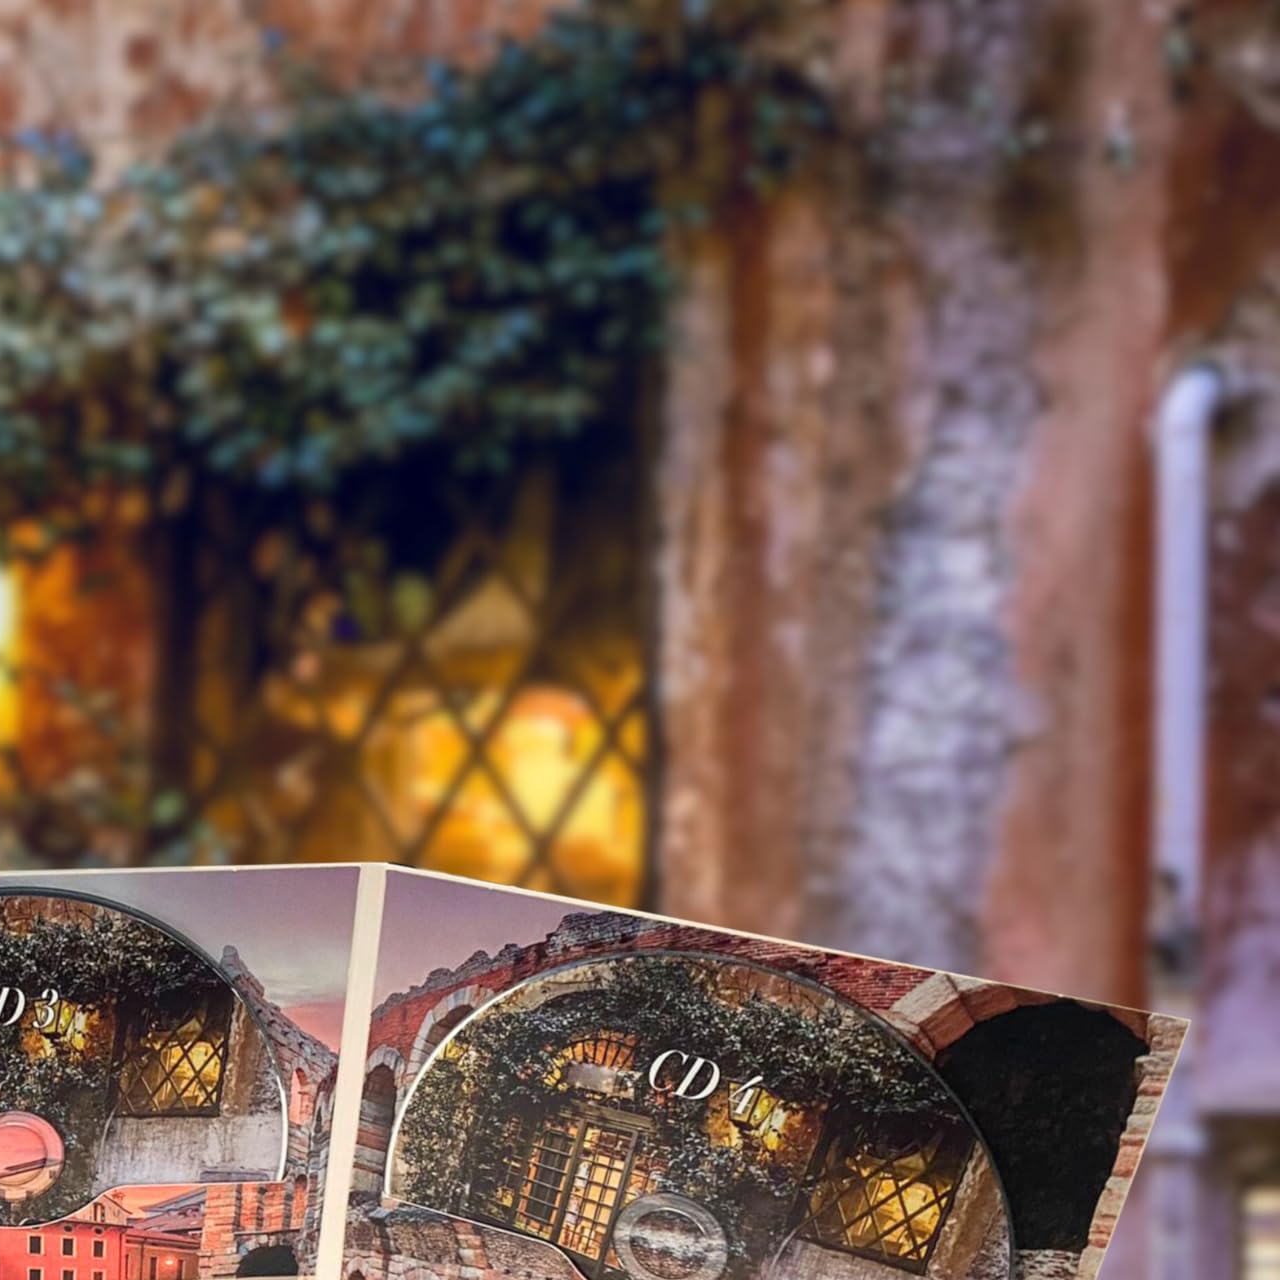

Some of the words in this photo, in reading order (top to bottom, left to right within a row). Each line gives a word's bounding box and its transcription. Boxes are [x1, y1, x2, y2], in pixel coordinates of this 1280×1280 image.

[32, 988, 59, 1029] 3
[648, 1049, 720, 1100] CD
[729, 1075, 763, 1115] 4
